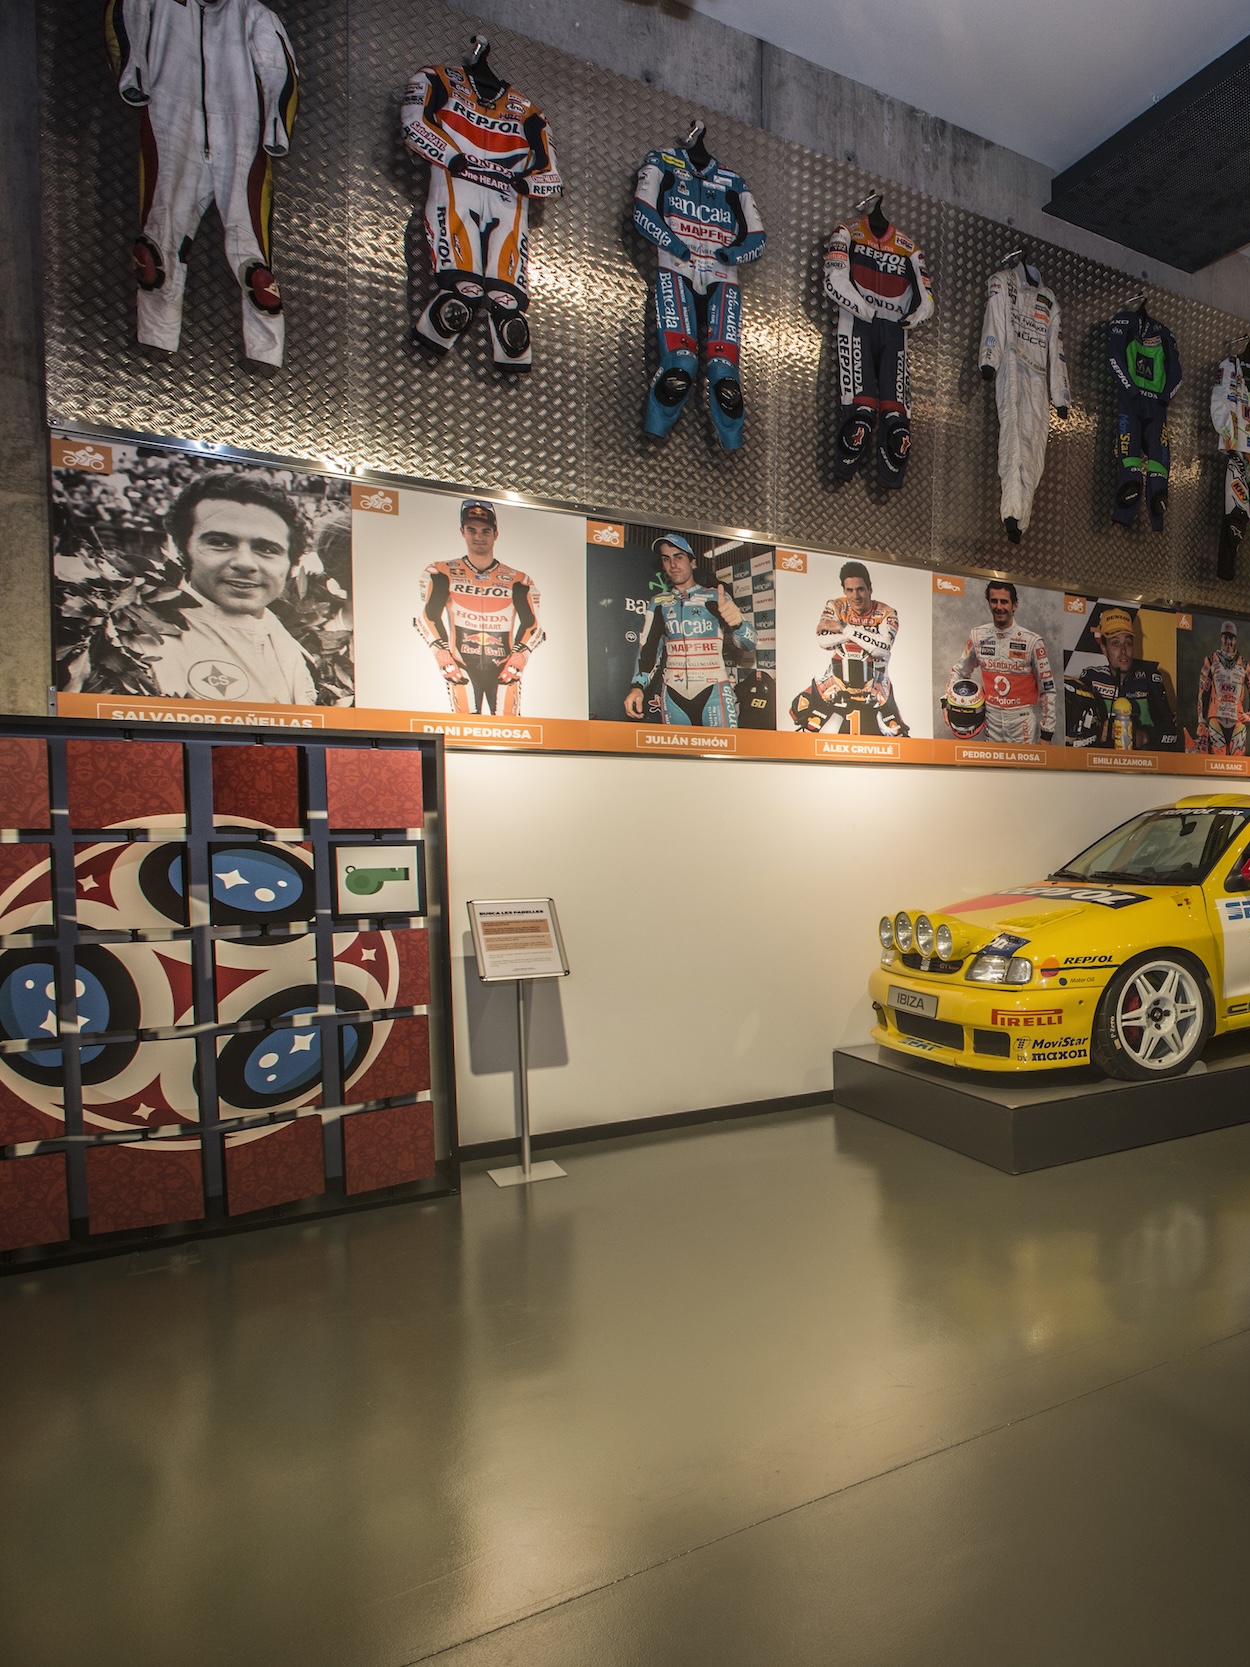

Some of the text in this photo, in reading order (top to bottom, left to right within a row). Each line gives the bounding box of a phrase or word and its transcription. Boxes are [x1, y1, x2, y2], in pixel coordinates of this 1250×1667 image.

[453, 100, 520, 134] REPSOL
[403, 126, 445, 163] REPSOL
[680, 223, 733, 245] MAPFRE
[854, 244, 906, 266] REPSOL
[876, 261, 906, 275] YPF
[659, 272, 680, 329] Bancaja
[725, 288, 739, 343] Bancaja
[838, 334, 852, 396] REPSOL
[853, 336, 863, 395] HONDA
[896, 350, 904, 404] HONDA
[1109, 358, 1131, 389] REPSOL
[454, 584, 509, 598] REPSOL
[456, 610, 509, 622] HONDA
[1106, 614, 1130, 622] DUNLOP
[465, 621, 478, 629] One
[461, 645, 506, 656] Red Bull
[671, 642, 718, 652] MAPFRE
[988, 659, 1026, 671] Santander
[207, 673, 231, 688] CS
[750, 698, 767, 709] 60
[988, 695, 1021, 705] vodafone
[111, 710, 313, 729] SALVADOR CAÑELLAS
[846, 710, 860, 735] 1
[423, 724, 532, 740] DANI PEDROSA
[645, 735, 728, 748] JULIÁN SIMÓN
[822, 742, 894, 755] ÀLEX CRIVILLÉ
[962, 750, 1040, 762] PEDRO DE LA ROSA
[1093, 757, 1152, 767] EMILI ALZAMORA
[1064, 955, 1113, 964] REPSOL
[897, 993, 924, 1010] IBIZA
[991, 1008, 1063, 1026] PIRELLI
[1032, 1036, 1089, 1049] MoviStar
[1017, 1048, 1088, 1063] by maxon
